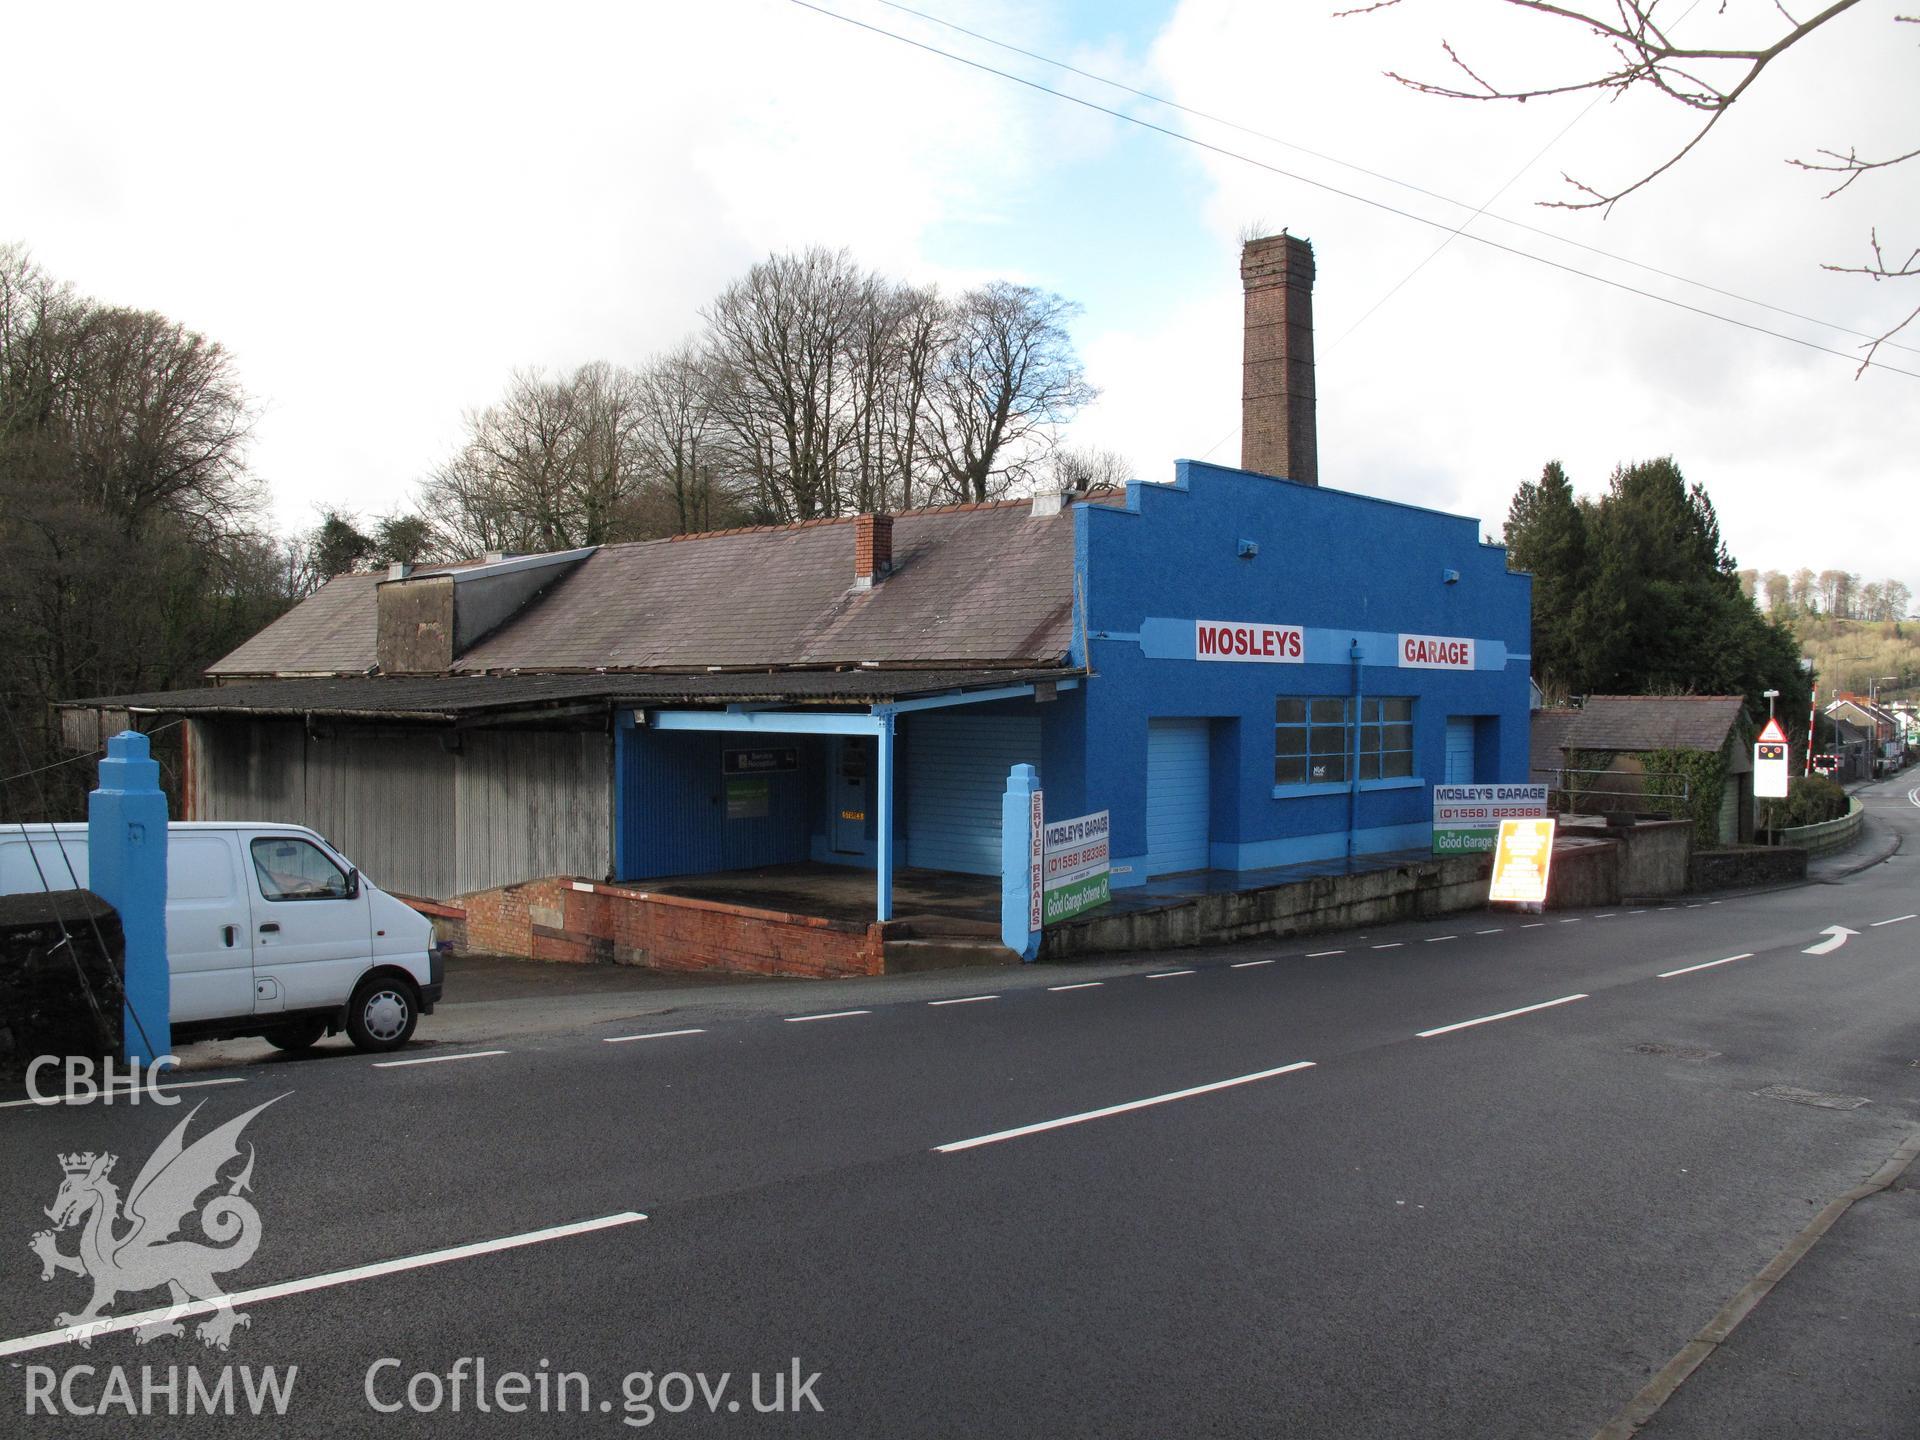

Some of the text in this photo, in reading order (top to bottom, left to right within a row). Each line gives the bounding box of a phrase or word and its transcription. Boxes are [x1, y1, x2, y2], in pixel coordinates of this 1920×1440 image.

[1199, 626, 1469, 665] MOSLEYS GARAGE
[1436, 788, 1545, 800] MOSLEY'S GARAGE
[1440, 807, 1541, 818] (01558) 823368
[1045, 816, 1108, 848] MOSLEY'S GARAGE
[1439, 836, 1461, 849] Good
[1463, 835, 1492, 851] Garage
[1032, 794, 1041, 925] SERVICE REPAIRS
[1048, 844, 1107, 873] (01558) 823368
[1047, 887, 1100, 916] Good Garage Scheme
